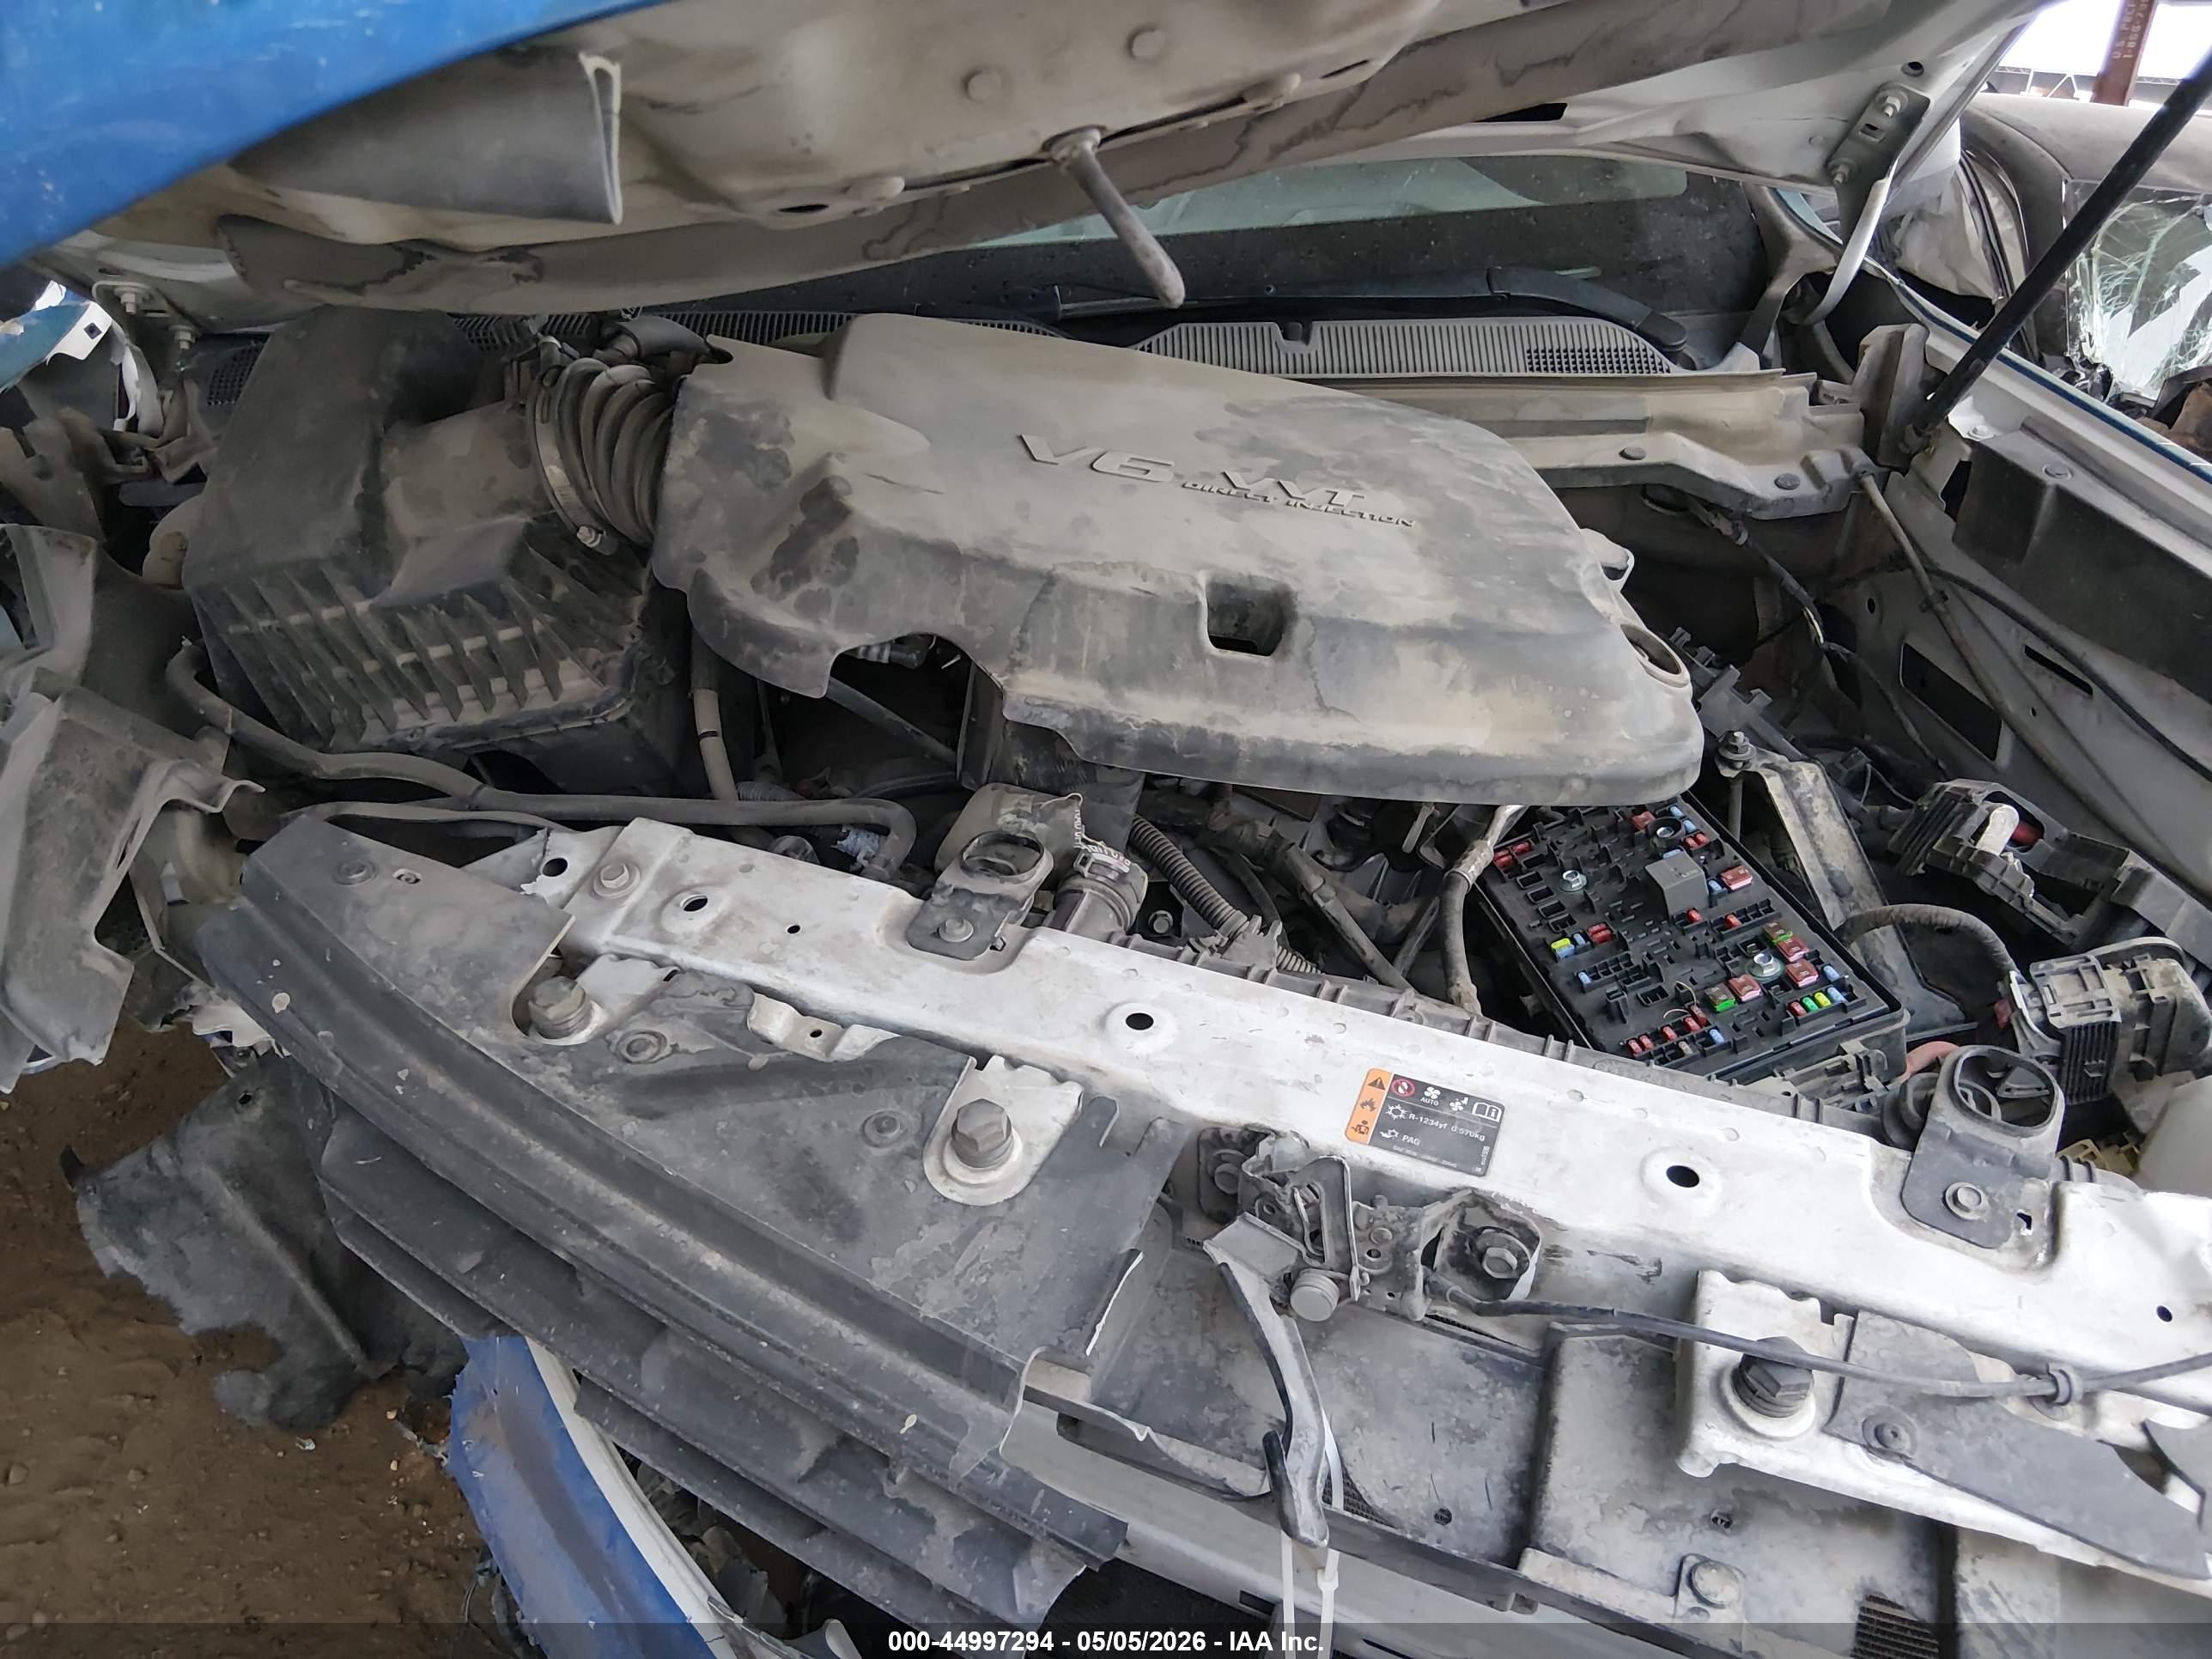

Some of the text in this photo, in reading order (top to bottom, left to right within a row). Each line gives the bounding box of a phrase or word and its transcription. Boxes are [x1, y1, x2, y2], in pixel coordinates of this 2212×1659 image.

[1018, 433, 1367, 507] V6 VVT
[1182, 481, 1416, 528] DIRECT INJECTION
[1419, 1097, 1439, 1106] AUTO
[1401, 1134, 1421, 1146] PAG
[1408, 1113, 1486, 1142] R-1234yf 0.570kg
